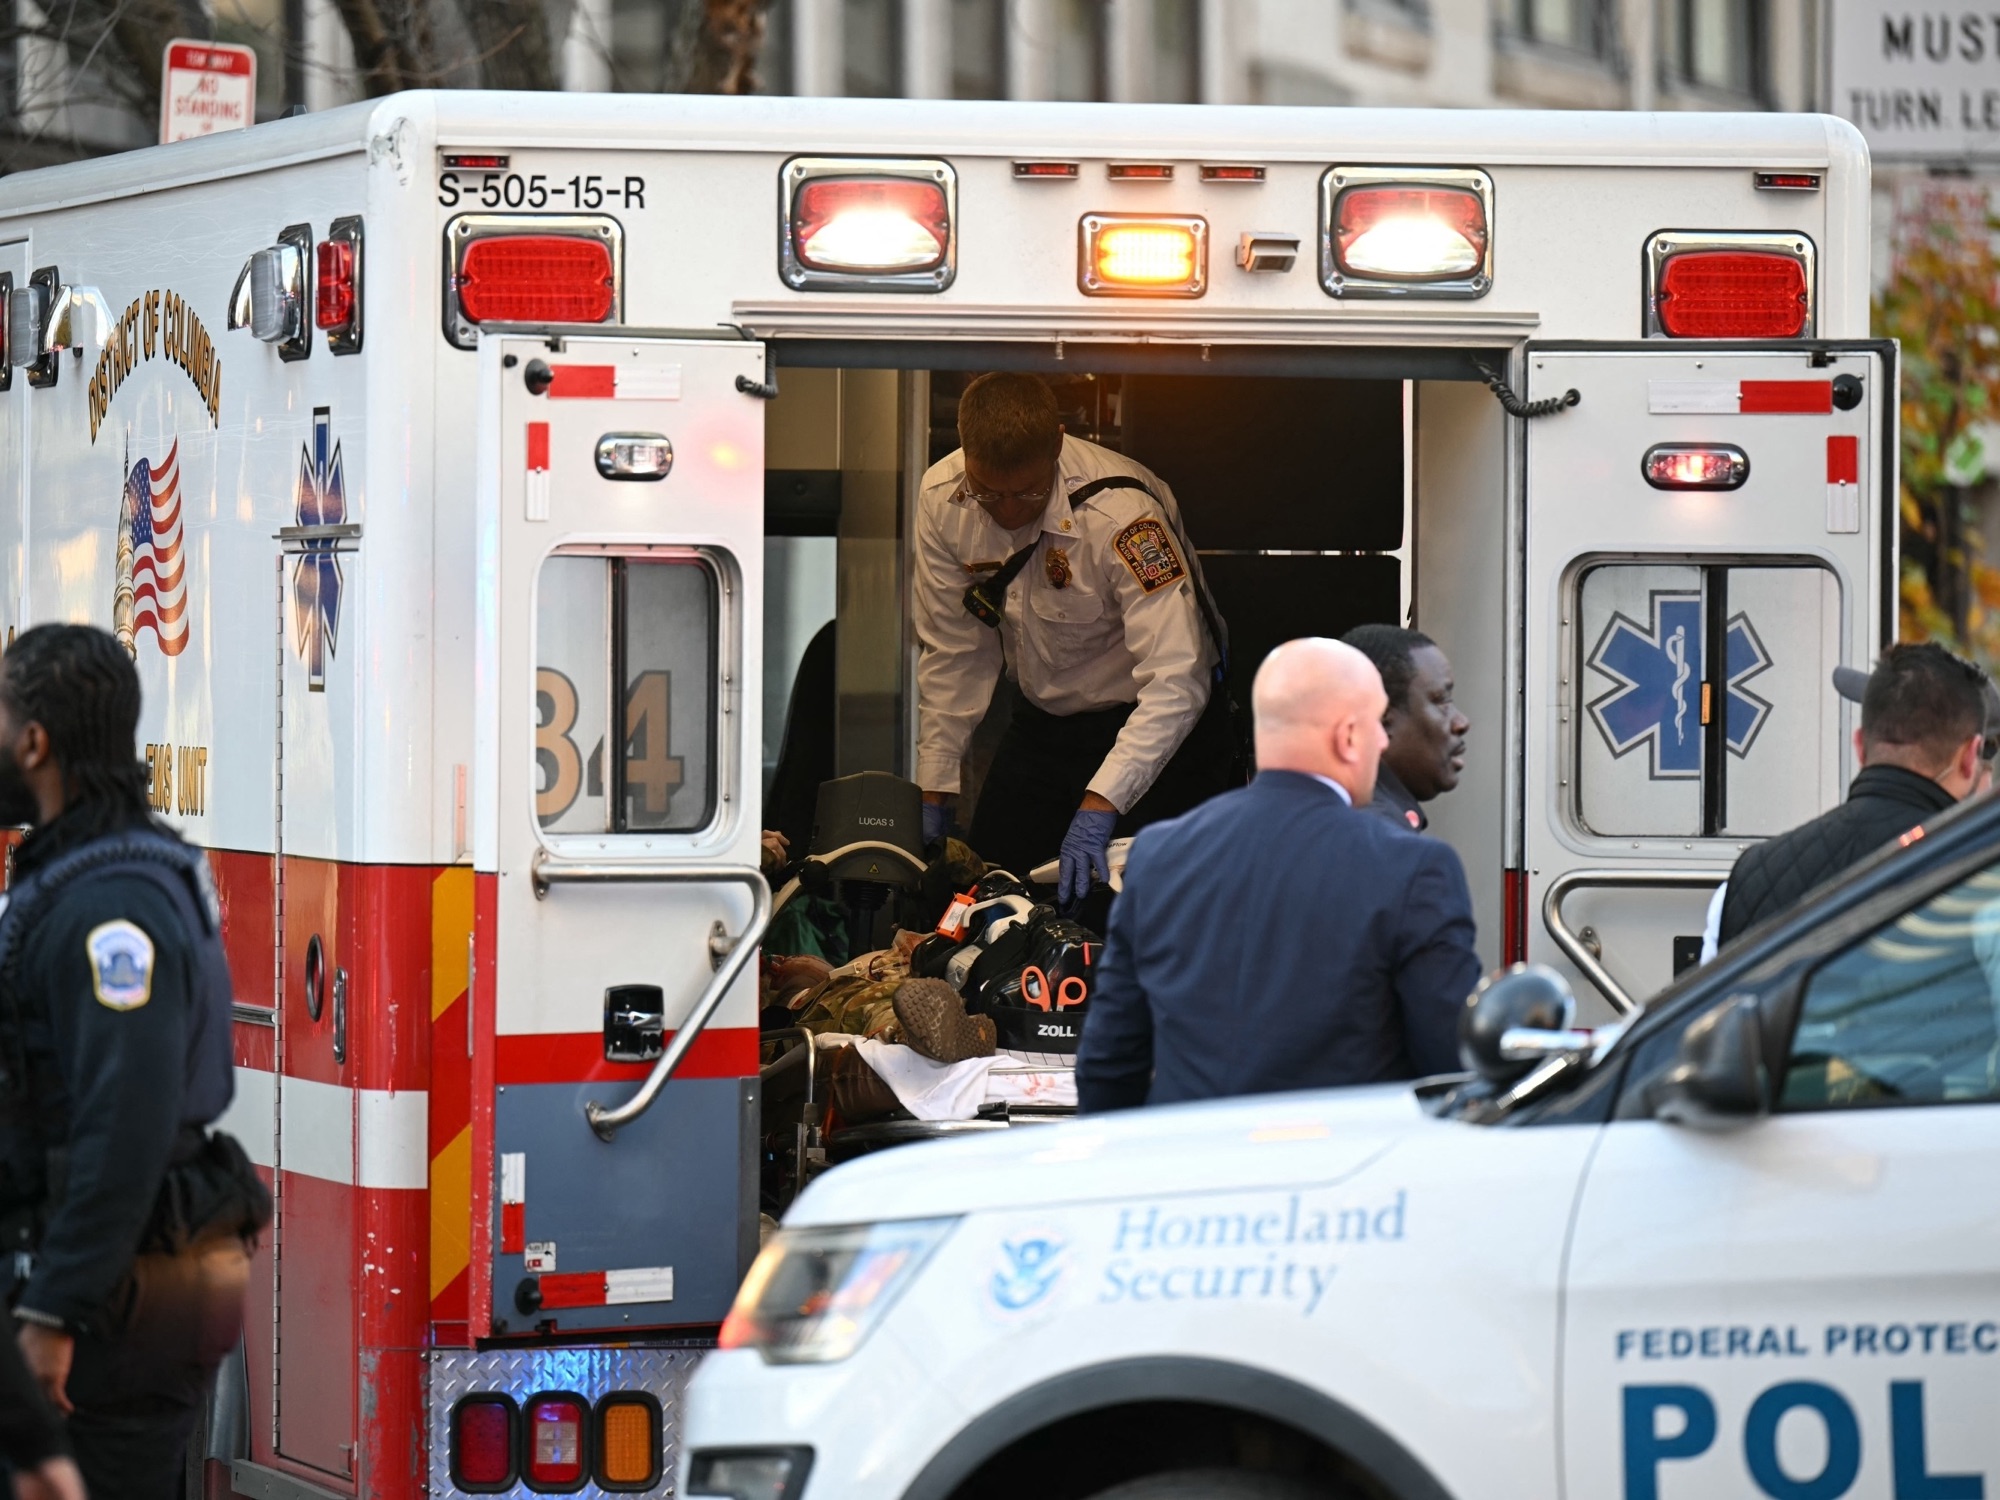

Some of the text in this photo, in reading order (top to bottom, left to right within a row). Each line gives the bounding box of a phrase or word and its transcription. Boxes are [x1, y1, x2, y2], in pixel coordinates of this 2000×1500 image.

[175, 96, 241, 119] STANDING
[1847, 88, 1942, 131] TURN
[438, 173, 646, 209] S-505-15-R
[88, 289, 222, 447] DISTRICT OF COLUMBIA
[1129, 526, 1139, 535] OF
[1132, 561, 1149, 584] FIRE
[1164, 547, 1178, 568] EMS
[1154, 572, 1173, 586] AND
[146, 743, 207, 817] EMS UNIT
[858, 816, 895, 827] LUCAS 3
[1112, 1188, 1408, 1252] Homeland
[1100, 1253, 1337, 1318] Security
[1616, 1322, 2000, 1358] FEDERAL PROTEC
[1622, 1378, 1985, 1500] POL
